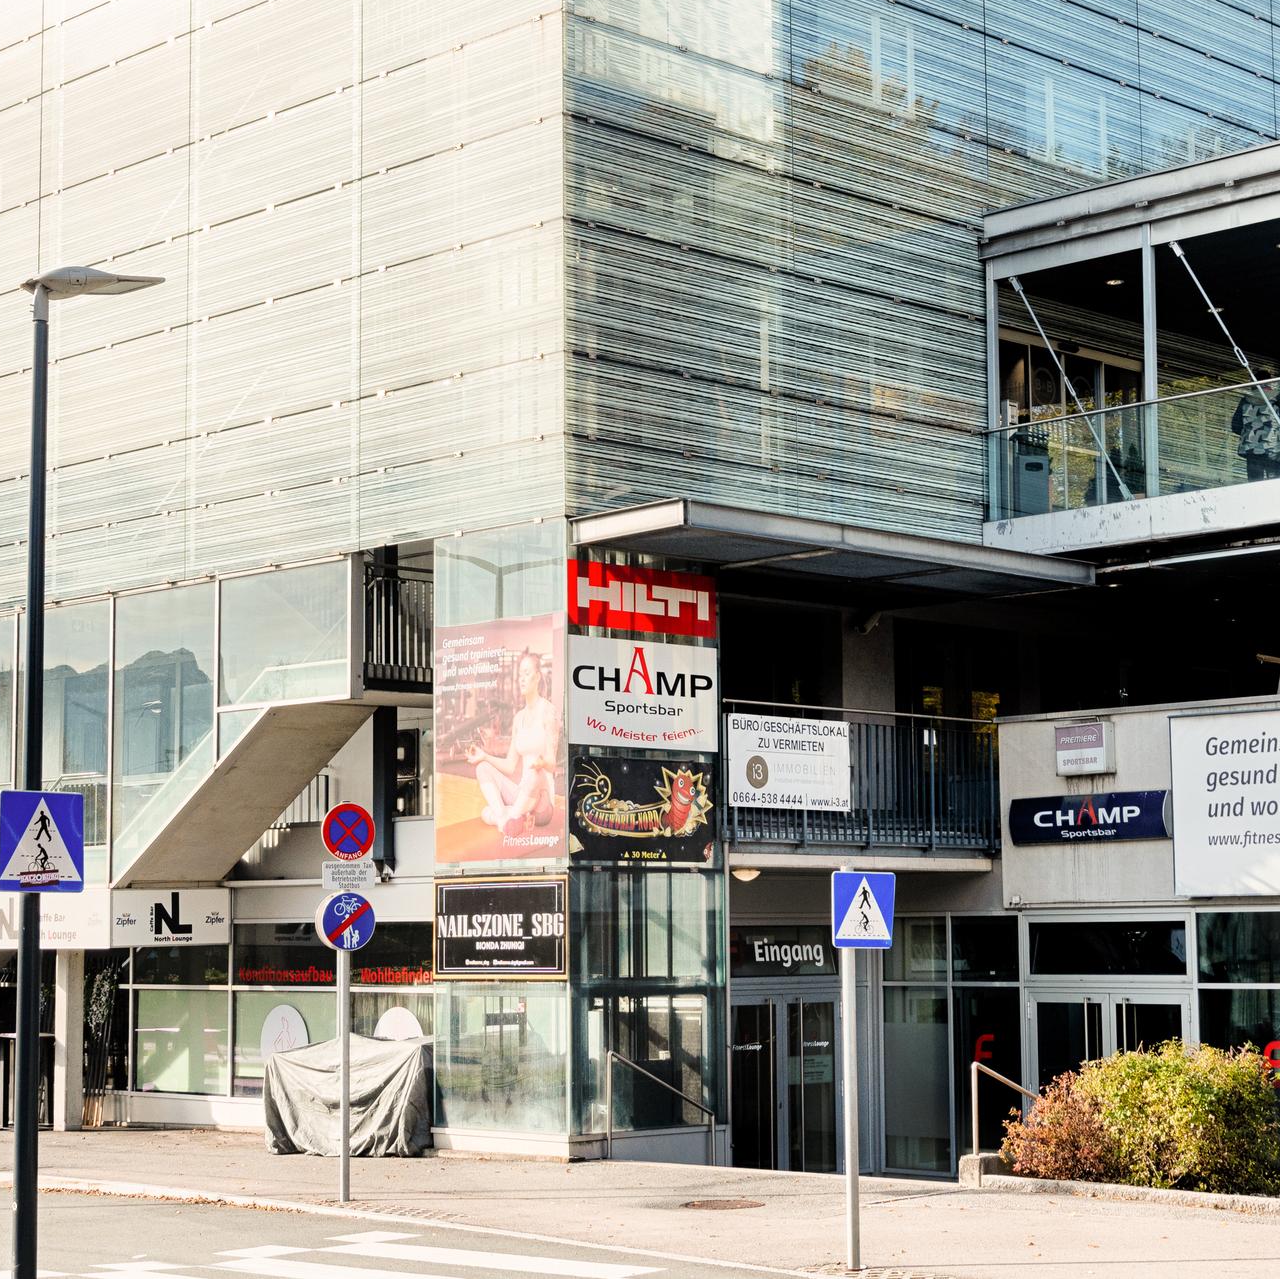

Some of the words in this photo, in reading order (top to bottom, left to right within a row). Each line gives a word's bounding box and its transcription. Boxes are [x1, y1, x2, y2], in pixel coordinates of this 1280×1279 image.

[577, 577, 709, 621] HILTI
[442, 635, 485, 648] Gemeinsam
[442, 650, 469, 666] gesund
[442, 666, 457, 678] und
[573, 647, 713, 698] CHAMP
[605, 700, 683, 716] Sportsbar
[587, 716, 607, 732] Wo
[611, 726, 658, 742] Meister
[732, 717, 848, 738] BÜRO/GESCHÄFTSLOKAL
[758, 737, 771, 749] ZU
[773, 738, 825, 752] VERMIETEN
[1060, 734, 1098, 745] PREMIERE
[1062, 756, 1098, 767] SPORTSBAR
[752, 763, 764, 780] i3
[1206, 763, 1278, 792] gesund
[733, 791, 778, 803] 0664-538
[779, 793, 803, 805] 4444
[1033, 794, 1141, 827] CHAMP
[1208, 796, 1245, 818] und
[502, 835, 560, 847] FitnessLounge
[1060, 828, 1117, 839] Sportsbar
[334, 850, 363, 860] ANFANG
[631, 851, 641, 859] 30
[641, 851, 660, 859] Meter
[115, 917, 137, 927] Zipfer
[205, 915, 225, 926] Zipfer
[437, 912, 565, 940] NAILSZONE_SBG
[48, 929, 77, 942] Lounge
[753, 937, 824, 967] Eingang
[239, 965, 333, 983] Konditionsaufbau
